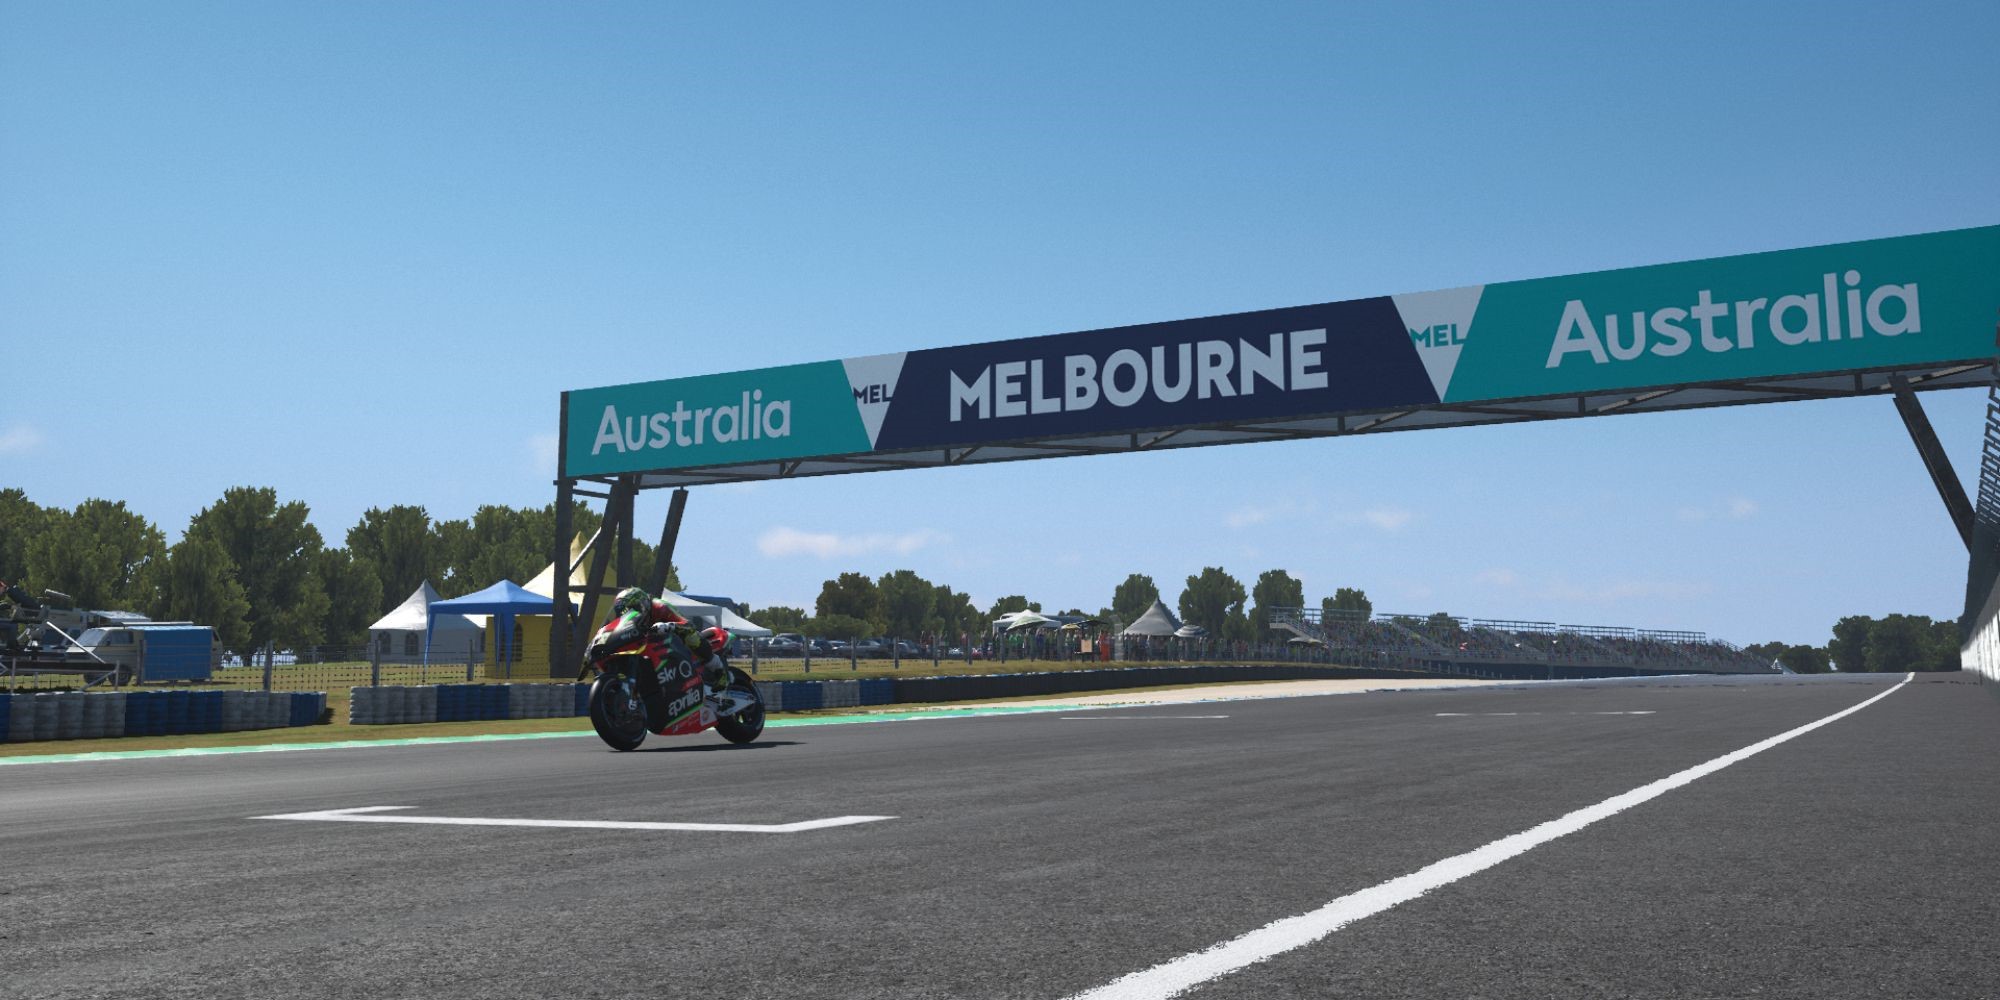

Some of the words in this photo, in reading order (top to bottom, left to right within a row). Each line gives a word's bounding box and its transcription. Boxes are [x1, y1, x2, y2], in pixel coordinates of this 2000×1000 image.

[1409, 323, 1467, 348] MEL
[1545, 269, 1921, 368] Australia
[852, 383, 893, 404] MEL
[950, 328, 1328, 422] MELBOURNE
[591, 389, 791, 455] Australia
